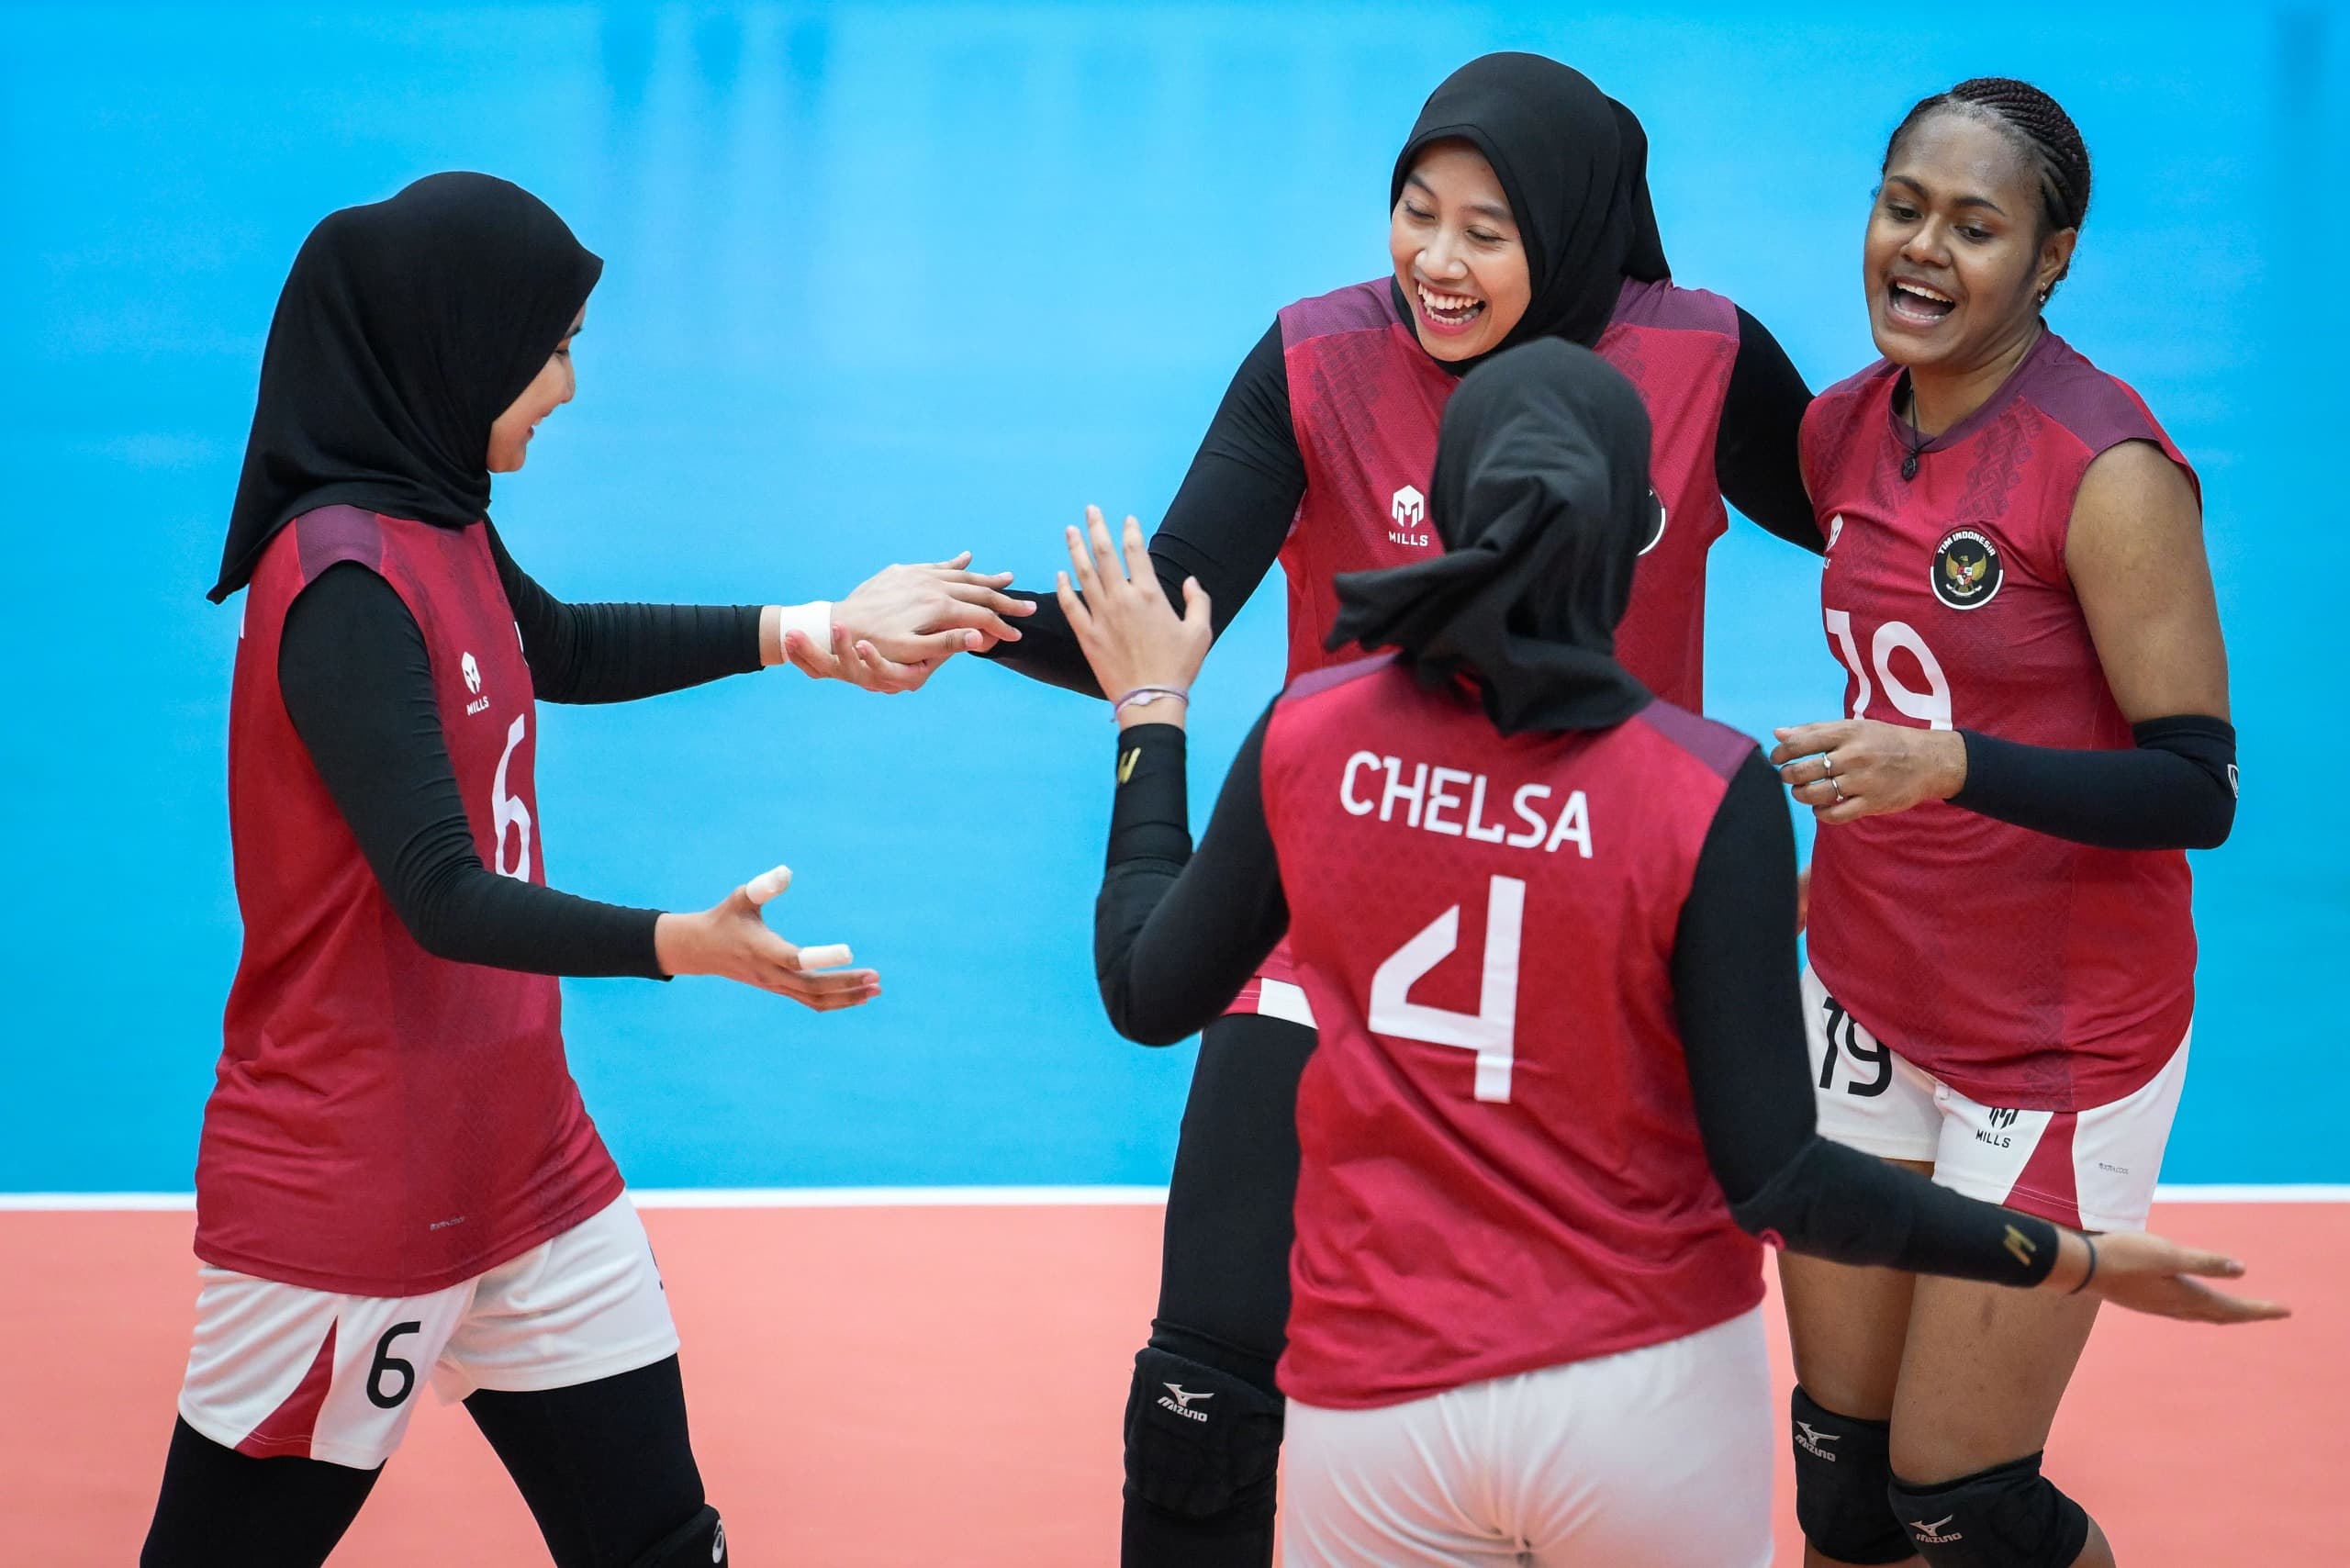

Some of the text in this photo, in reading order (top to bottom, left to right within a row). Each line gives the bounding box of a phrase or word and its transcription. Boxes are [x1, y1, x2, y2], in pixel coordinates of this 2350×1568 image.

[1389, 531, 1428, 547] MILLS
[1938, 532, 1996, 556] TIM INDONESIA
[466, 696, 489, 716] MILLS
[492, 713, 531, 882] 6
[1339, 750, 1594, 859] CHELSA
[1368, 874, 1526, 1103] 4
[1818, 996, 1893, 1097] 19
[1975, 1128, 2011, 1148] MILLS
[366, 1321, 421, 1408] 6
[1158, 1395, 1208, 1422] MIZUNO
[1795, 1433, 1836, 1462] MIZUNO
[1916, 1532, 1963, 1543] MIZUNO
